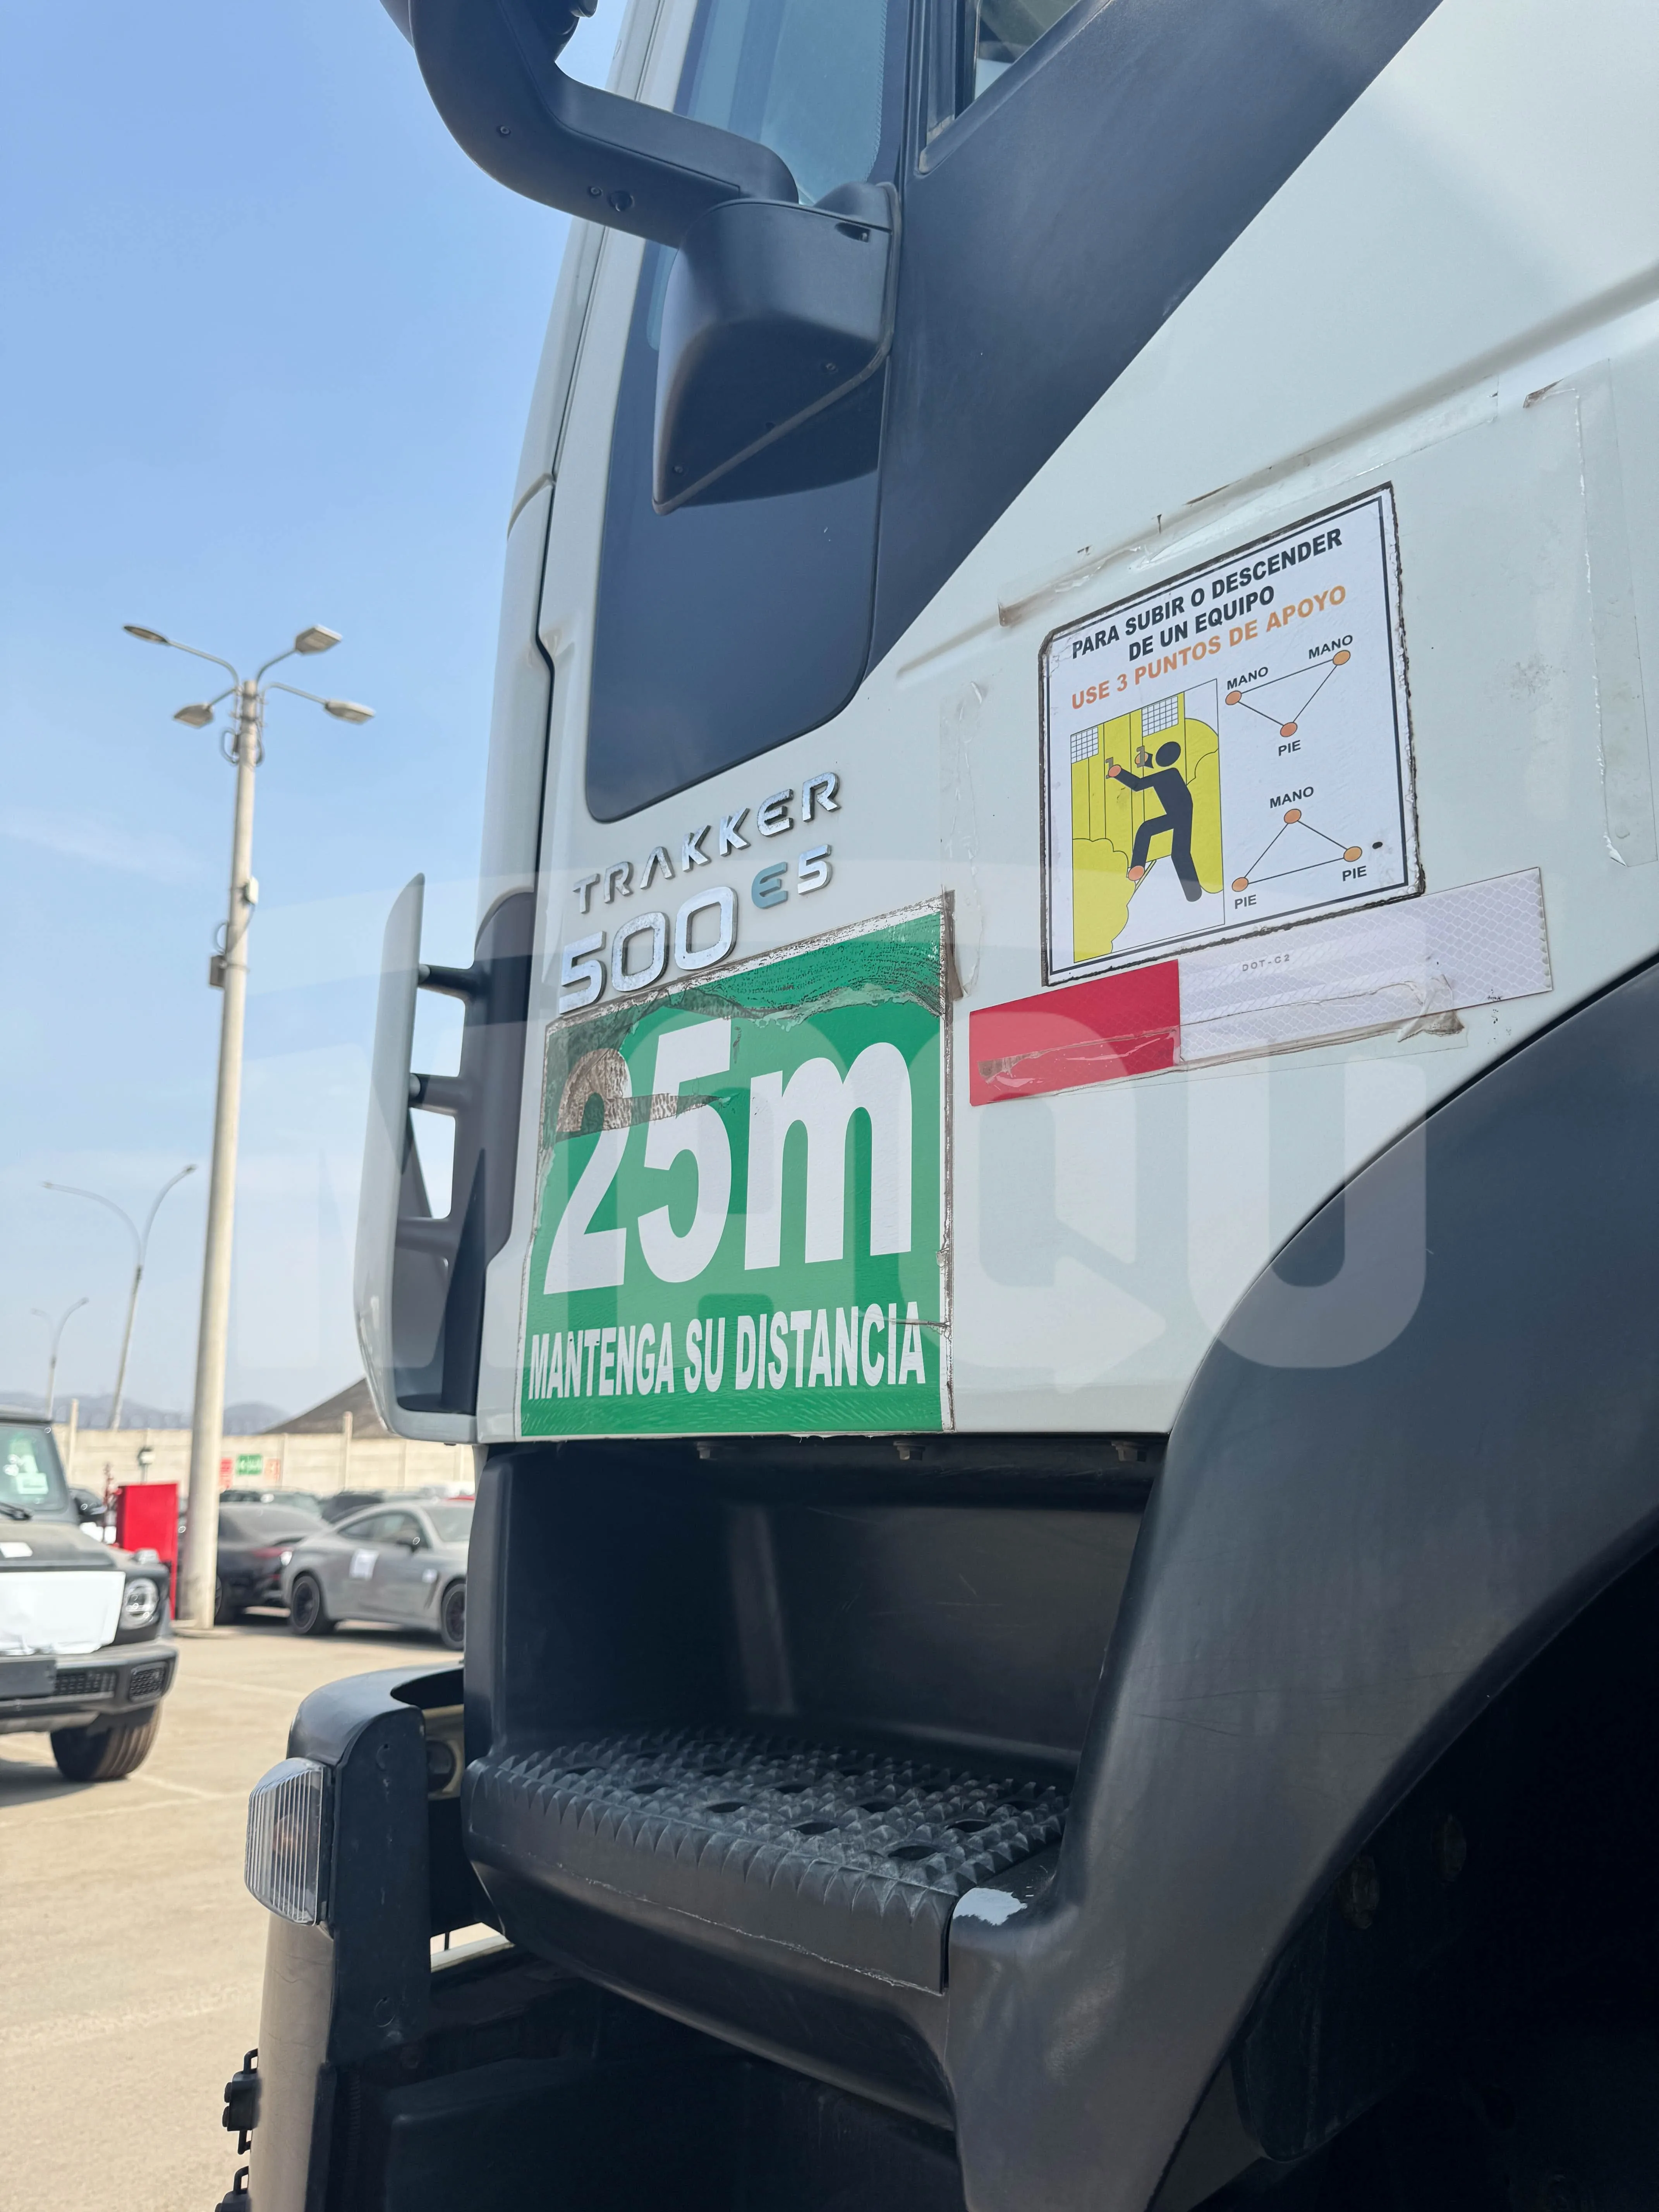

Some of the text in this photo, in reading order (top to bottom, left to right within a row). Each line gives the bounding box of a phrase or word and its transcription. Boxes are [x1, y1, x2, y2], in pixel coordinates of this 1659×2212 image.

[1072, 528, 1343, 659] PARA SUBIR O DESCENDER
[1072, 586, 1346, 709] USE 3 PUNTOS DE APOYO
[1129, 586, 1274, 661] DE UN EQUIPO
[1309, 635, 1353, 659] MANO
[1227, 666, 1268, 690] MANO
[1278, 740, 1301, 756] PIE
[1270, 787, 1314, 808] MANO
[573, 772, 840, 914] TRAKKER
[1342, 866, 1367, 881] PIE
[1235, 895, 1257, 909] PIE
[559, 844, 832, 1014] 500 E5
[1242, 954, 1290, 972] DOT-C2
[544, 1018, 912, 1295] 25m
[528, 1302, 926, 1400] MANTENGA SU DISTANCIA
